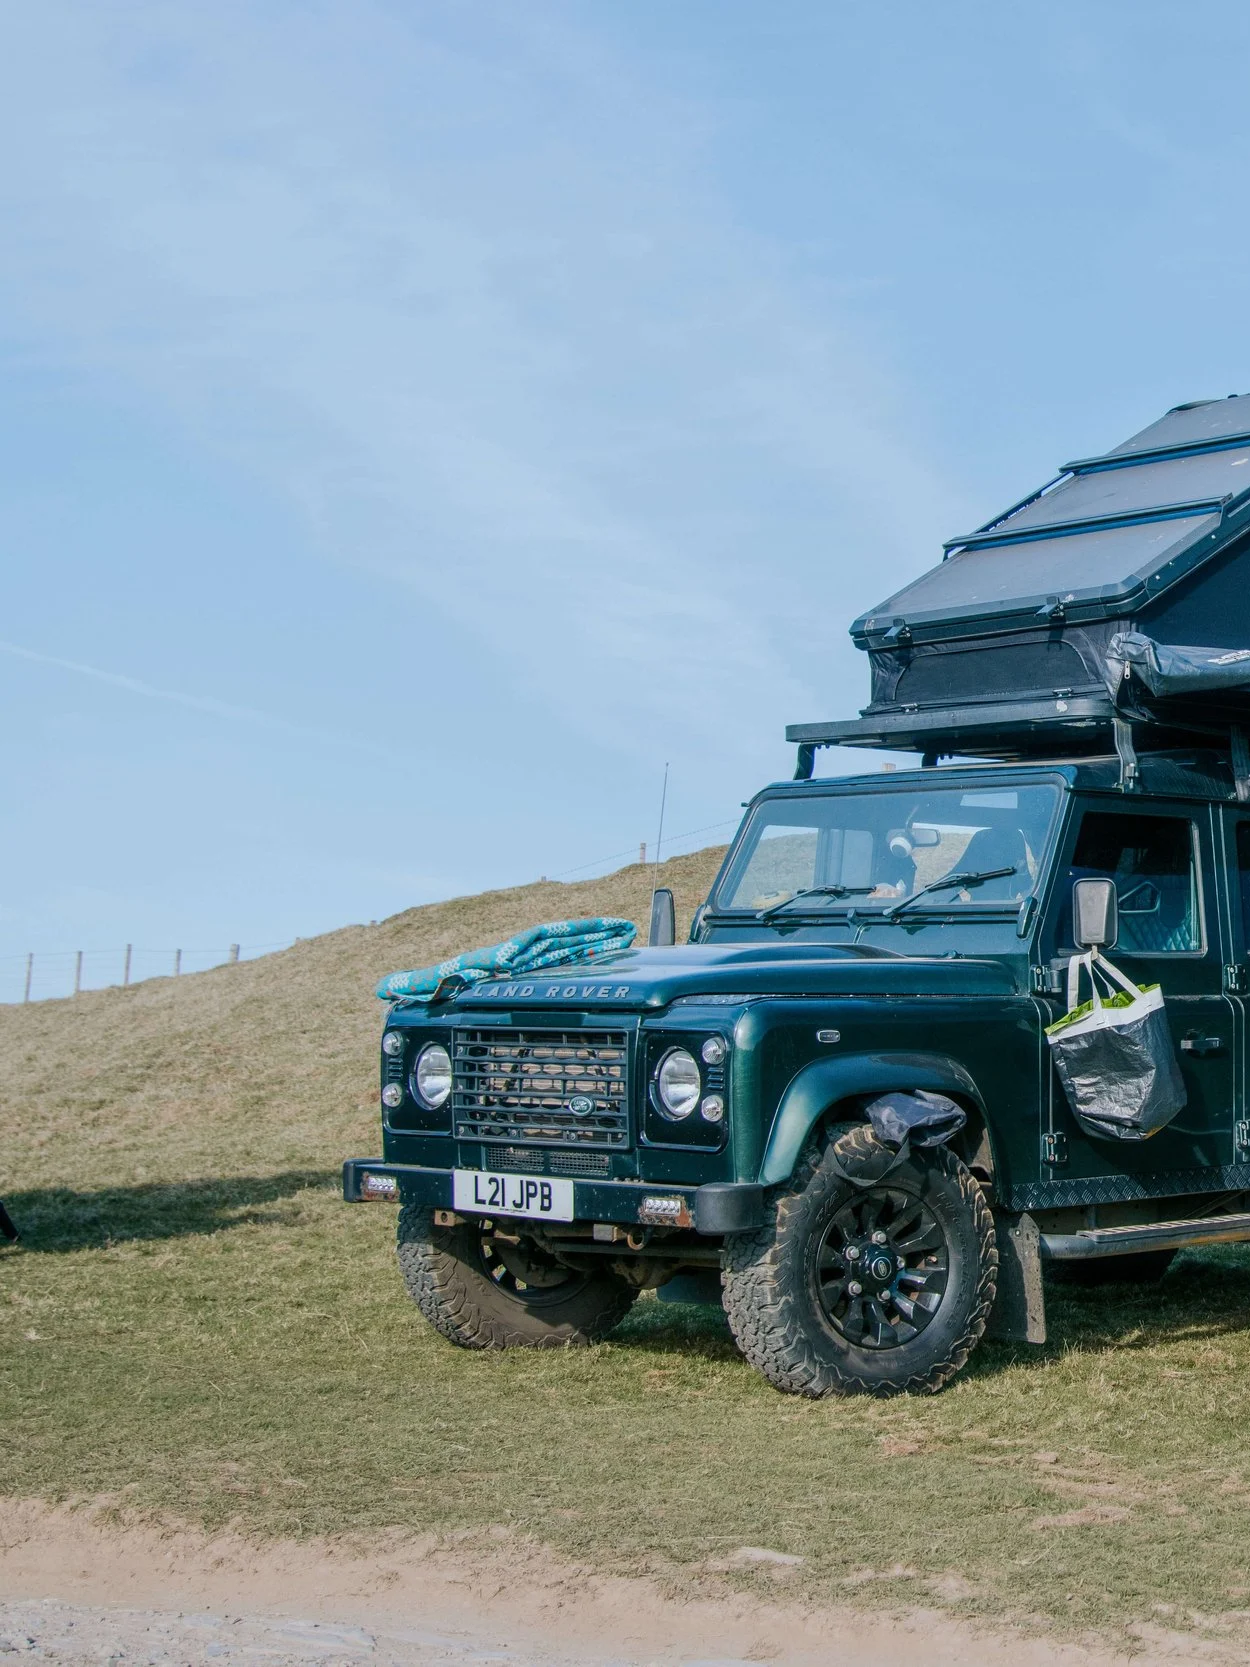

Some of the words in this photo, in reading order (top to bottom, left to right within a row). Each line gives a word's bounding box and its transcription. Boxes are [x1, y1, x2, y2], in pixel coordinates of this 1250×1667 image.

[472, 985, 535, 997] LAND
[545, 986, 630, 998] ROVER
[474, 1175, 506, 1207] L21
[512, 1180, 552, 1212] JPB
